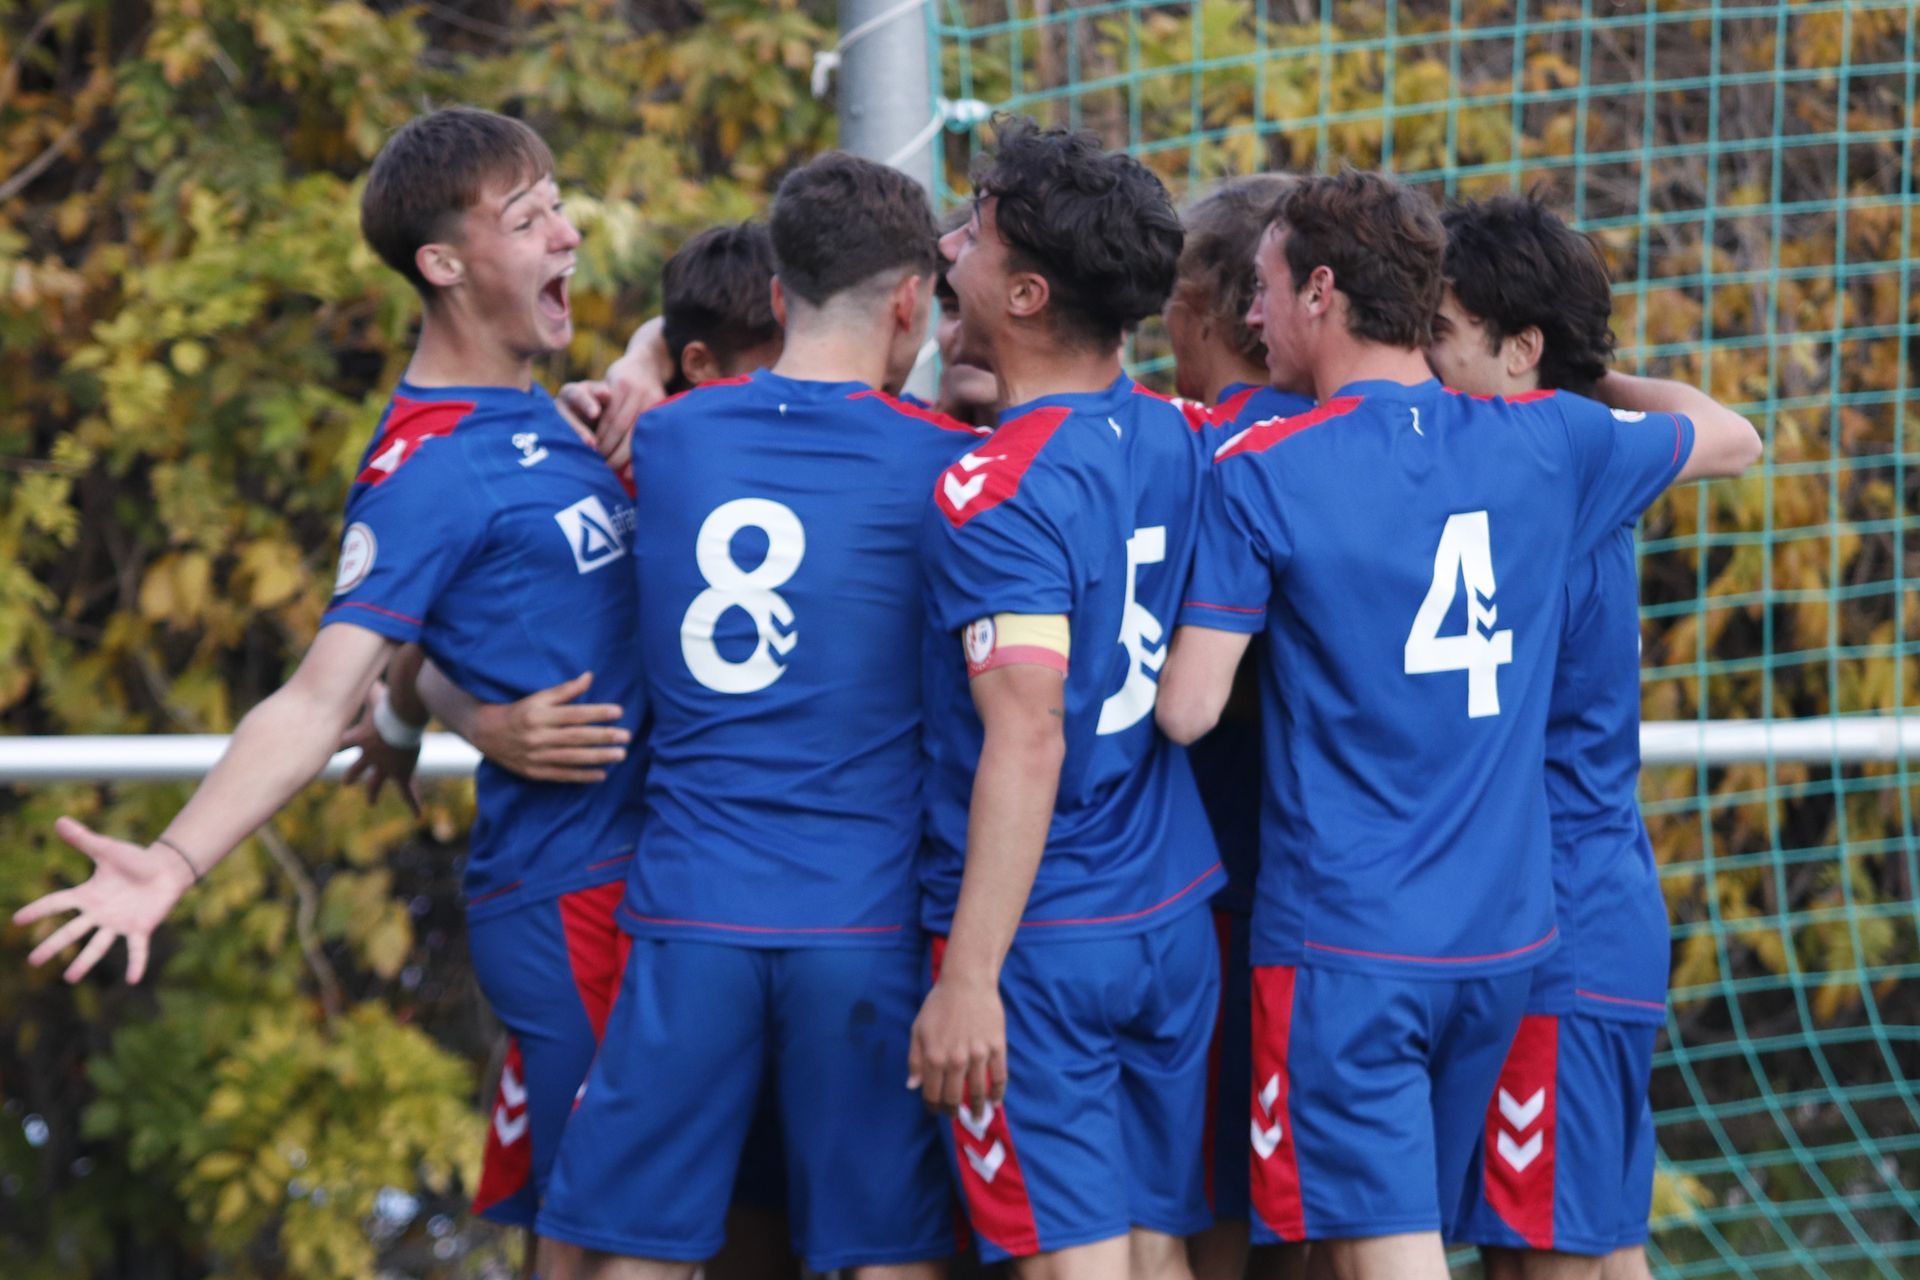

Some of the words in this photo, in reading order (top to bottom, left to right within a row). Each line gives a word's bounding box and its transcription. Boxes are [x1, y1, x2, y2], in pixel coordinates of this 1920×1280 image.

[680, 497, 806, 694] 8
[1096, 525, 1167, 735] 5
[1404, 510, 1513, 718] 4
